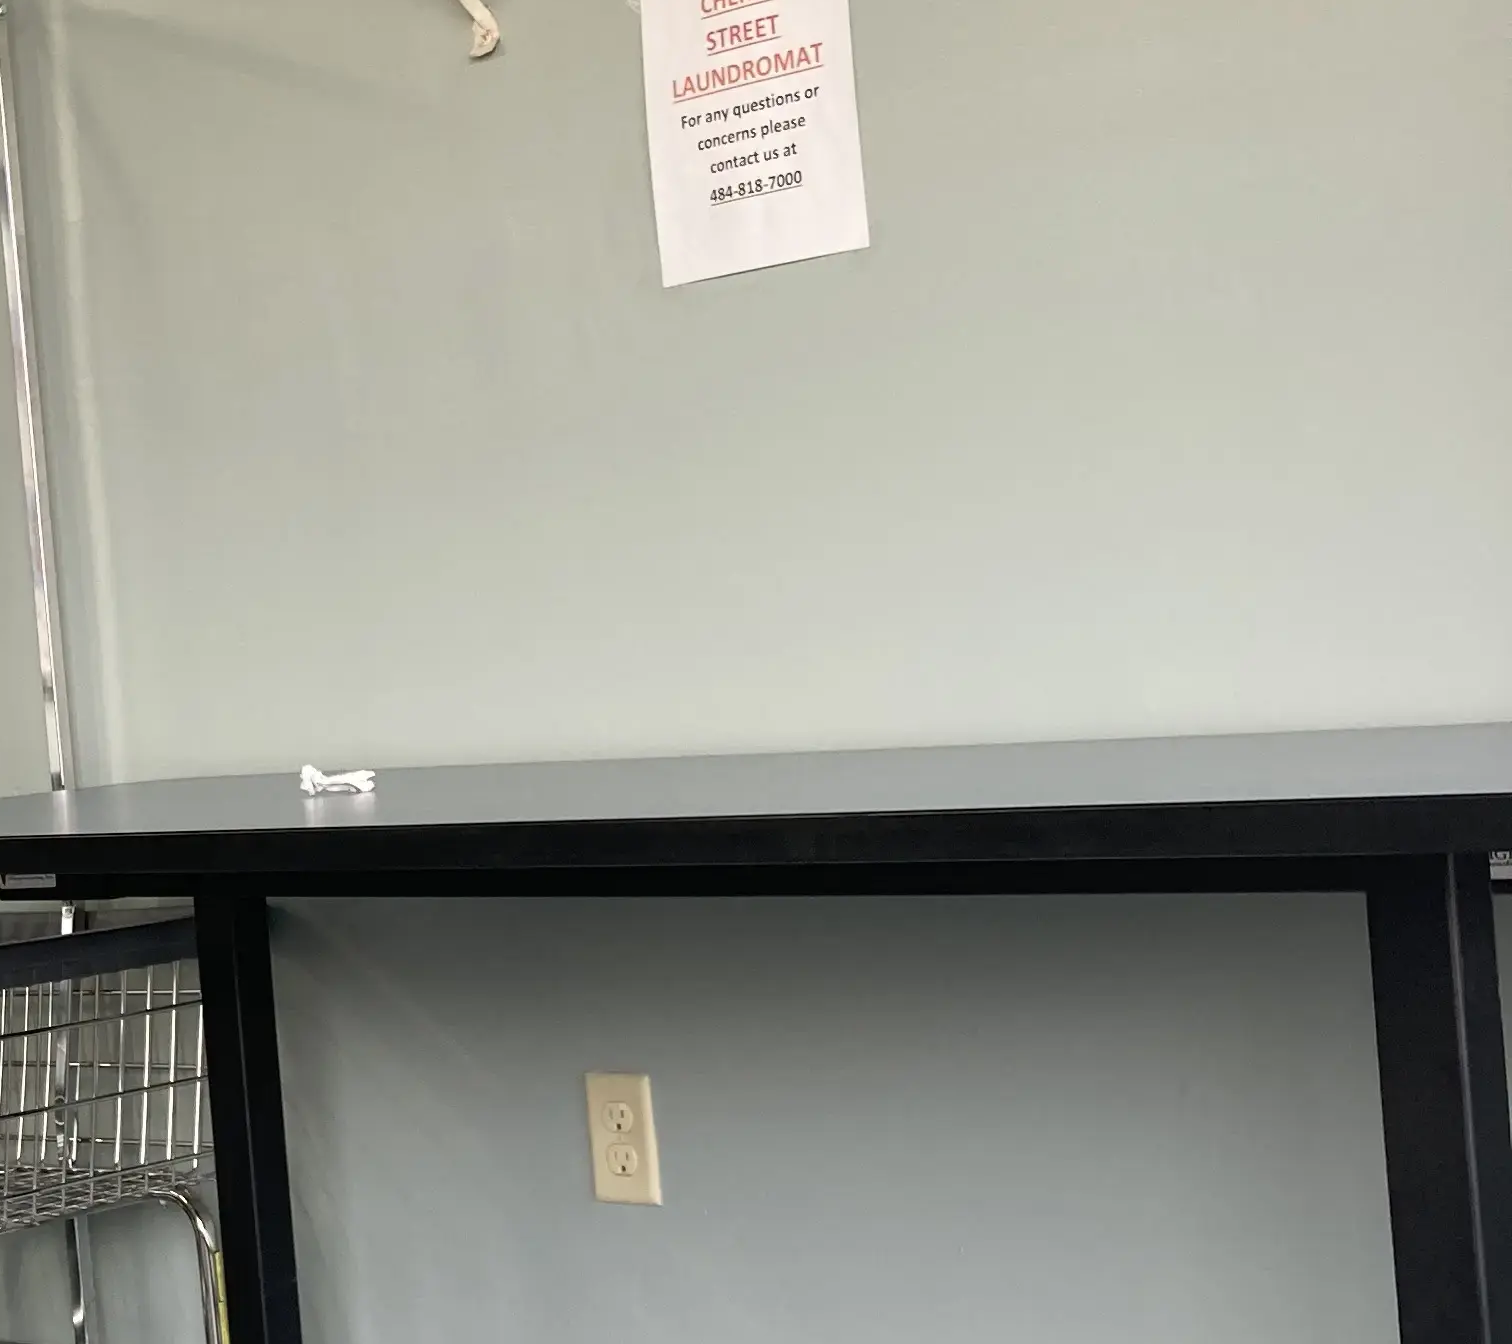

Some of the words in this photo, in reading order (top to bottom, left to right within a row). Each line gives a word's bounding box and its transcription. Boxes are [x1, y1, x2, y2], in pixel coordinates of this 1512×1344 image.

[706, 15, 780, 53] STREET
[672, 43, 823, 101] LAUNDROMAT
[681, 113, 703, 130] For
[705, 107, 729, 126] any
[732, 92, 801, 119] questions
[804, 86, 819, 100] or
[698, 127, 757, 151] concerns
[761, 115, 806, 137] please
[710, 151, 760, 174] contact
[763, 147, 779, 161] us
[783, 143, 797, 157] at
[710, 171, 803, 203] 484-818-7000
